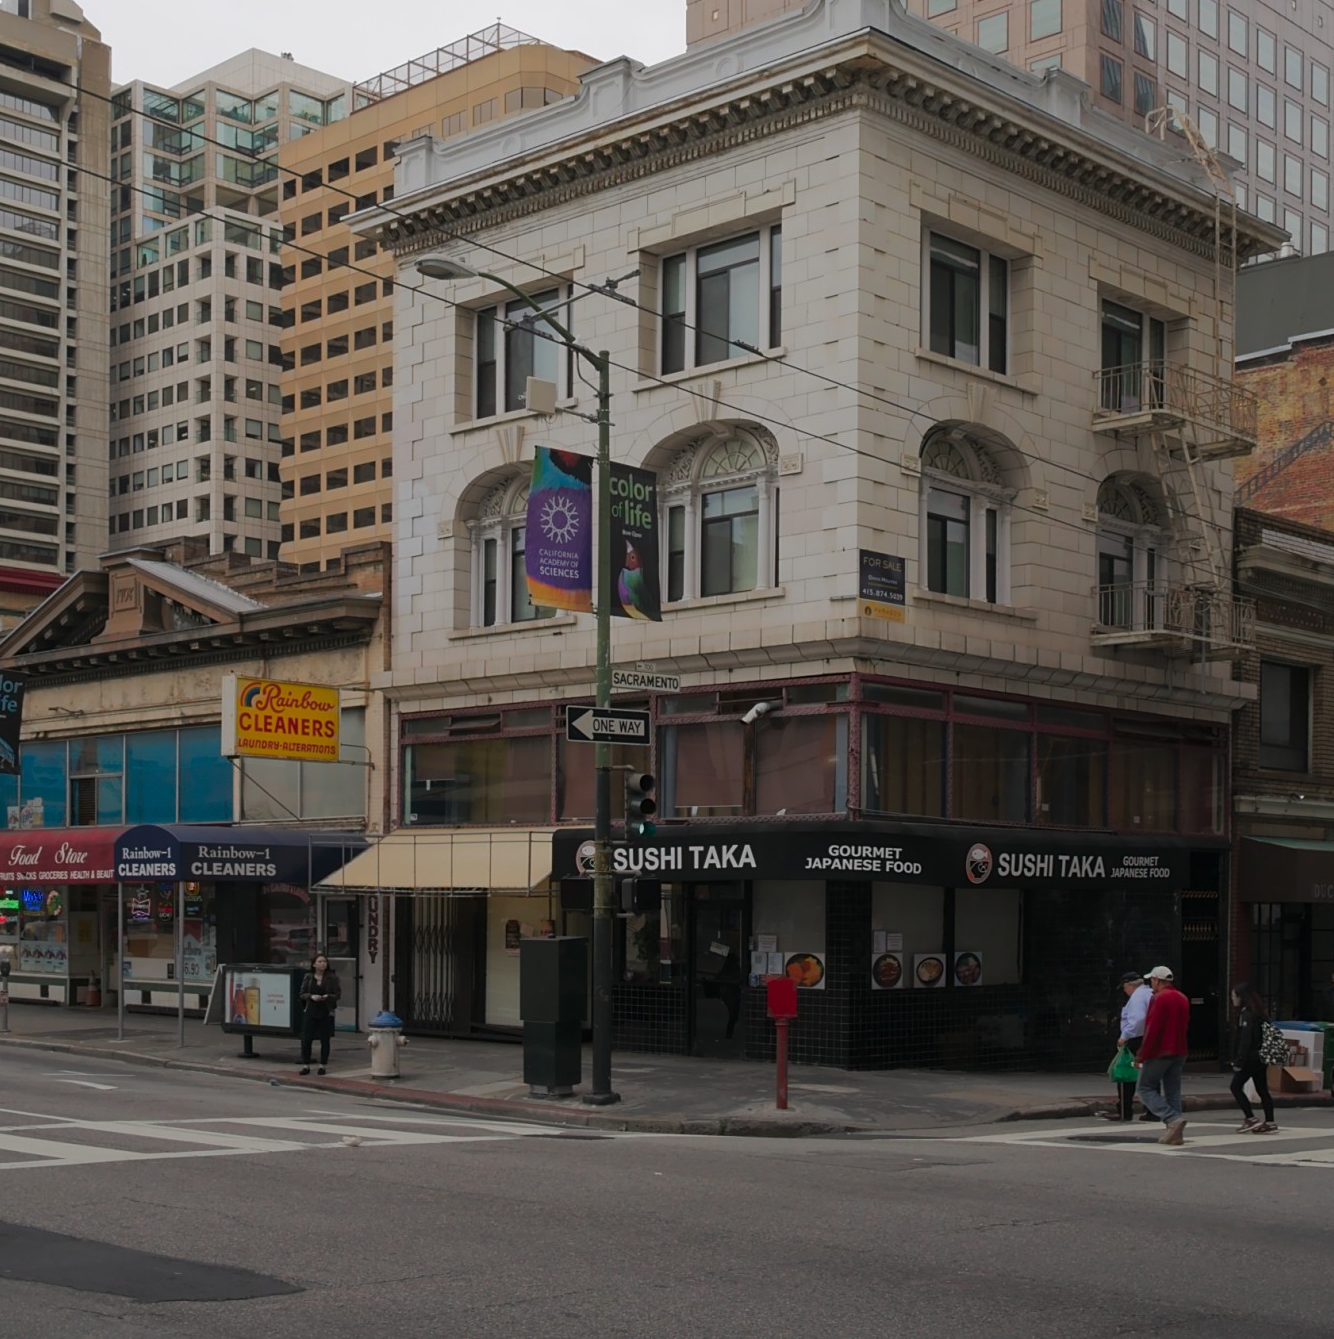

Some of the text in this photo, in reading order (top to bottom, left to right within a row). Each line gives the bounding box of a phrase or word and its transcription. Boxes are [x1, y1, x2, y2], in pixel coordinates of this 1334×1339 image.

[609, 473, 653, 502] color
[612, 500, 652, 529] of life
[539, 548, 579, 559] CALIFORNIA
[539, 557, 571, 568] ACADEMY
[863, 556, 902, 572] FOR SALE
[540, 566, 579, 579] SCIENCES
[613, 672, 679, 689] SACRAMENTO
[255, 683, 335, 713] Rainbow
[239, 712, 335, 738] CLEANERS
[592, 719, 642, 734] ONE WAY
[8, 841, 88, 866] Food Store
[122, 846, 171, 860] Rainbow-1
[198, 845, 271, 860] Rainbow-1
[613, 843, 757, 871] SUSHI TAKA
[827, 844, 903, 861] GOURMET
[804, 857, 923, 875] JAPANESE FOOD
[997, 852, 1106, 879] SUSHI TAKA
[1122, 855, 1160, 867] GOURMET
[38, 871, 69, 880] GROCERIES
[70, 870, 90, 879] HEALTH
[96, 869, 115, 879] BEAUT
[118, 863, 176, 877] CLEANERS
[191, 862, 277, 877] CLEANERS
[1110, 867, 1171, 879] JAPANESE FOOD
